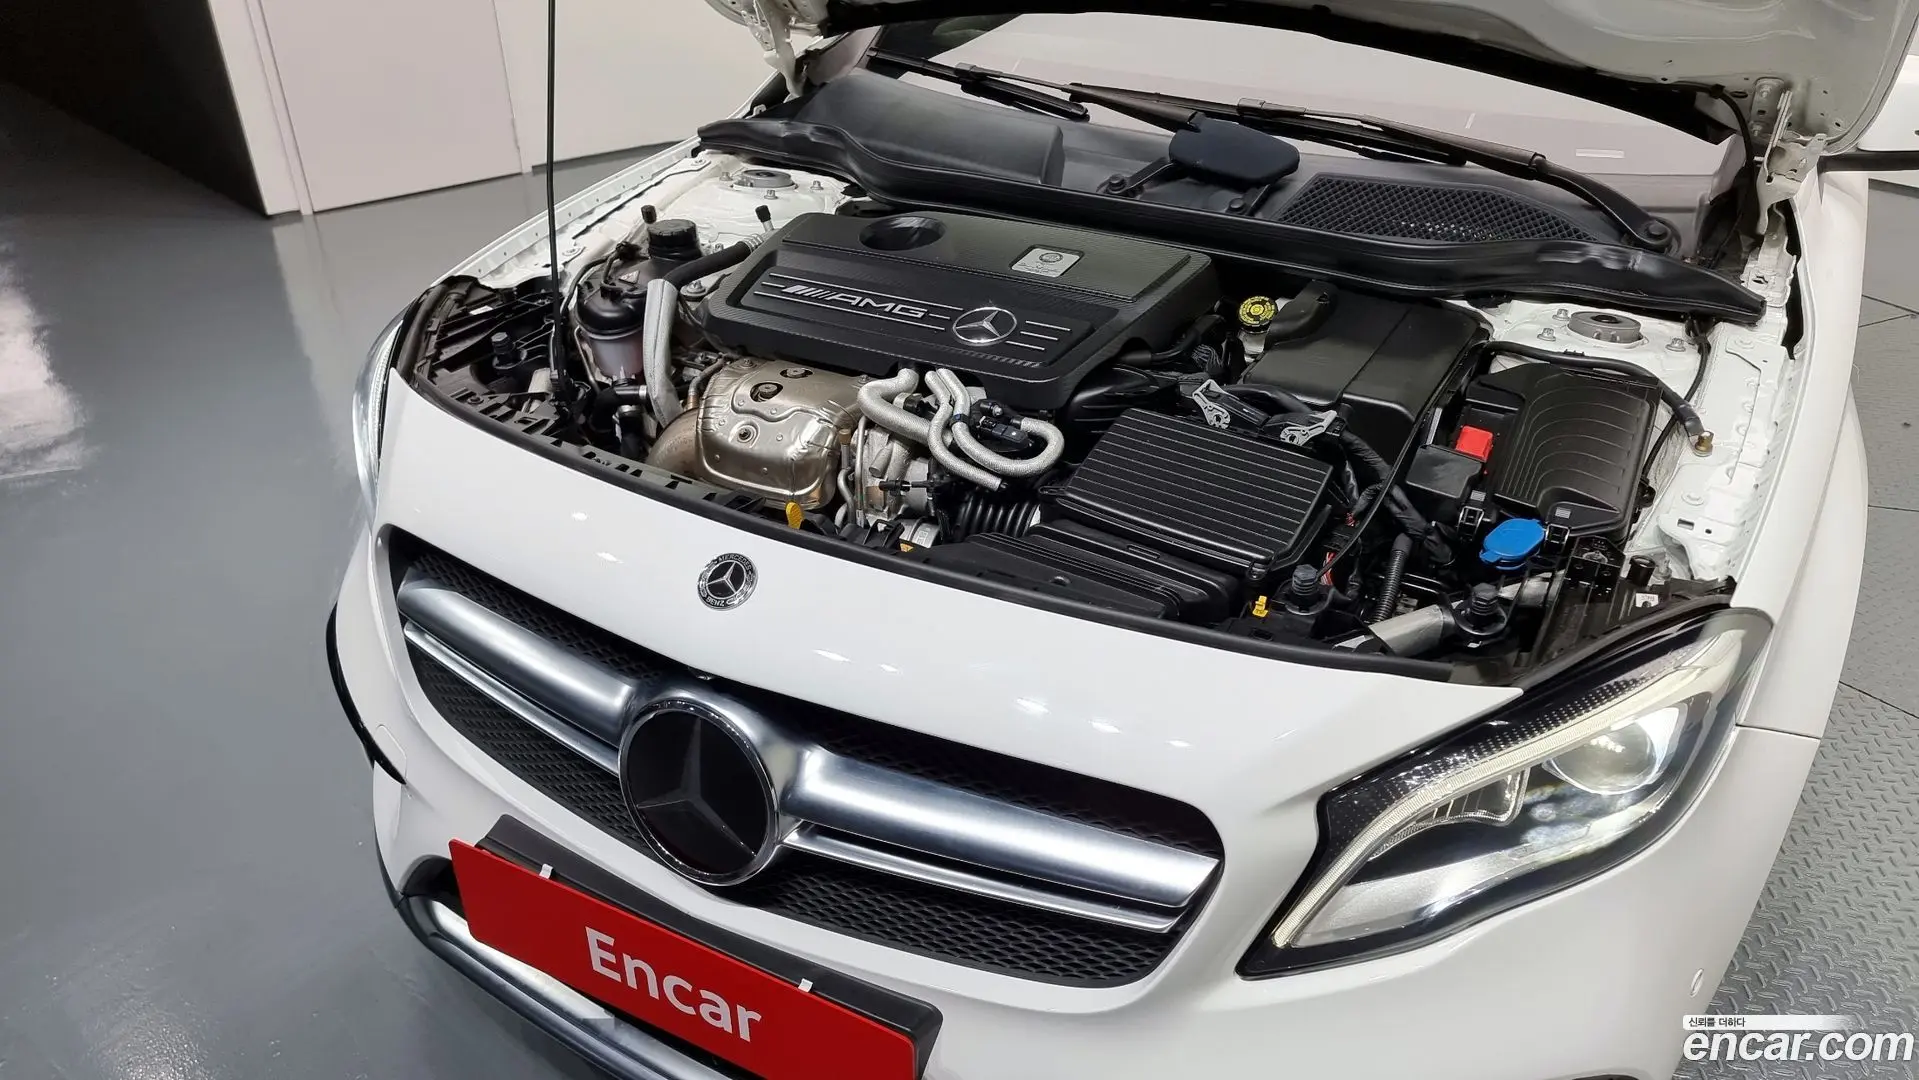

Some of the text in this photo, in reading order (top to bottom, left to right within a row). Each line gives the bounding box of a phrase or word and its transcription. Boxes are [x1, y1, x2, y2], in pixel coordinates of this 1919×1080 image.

[826, 293, 928, 318] AMG
[718, 554, 752, 571] MERCEDES
[707, 597, 725, 607] BENZ
[585, 925, 762, 1043] Encar
